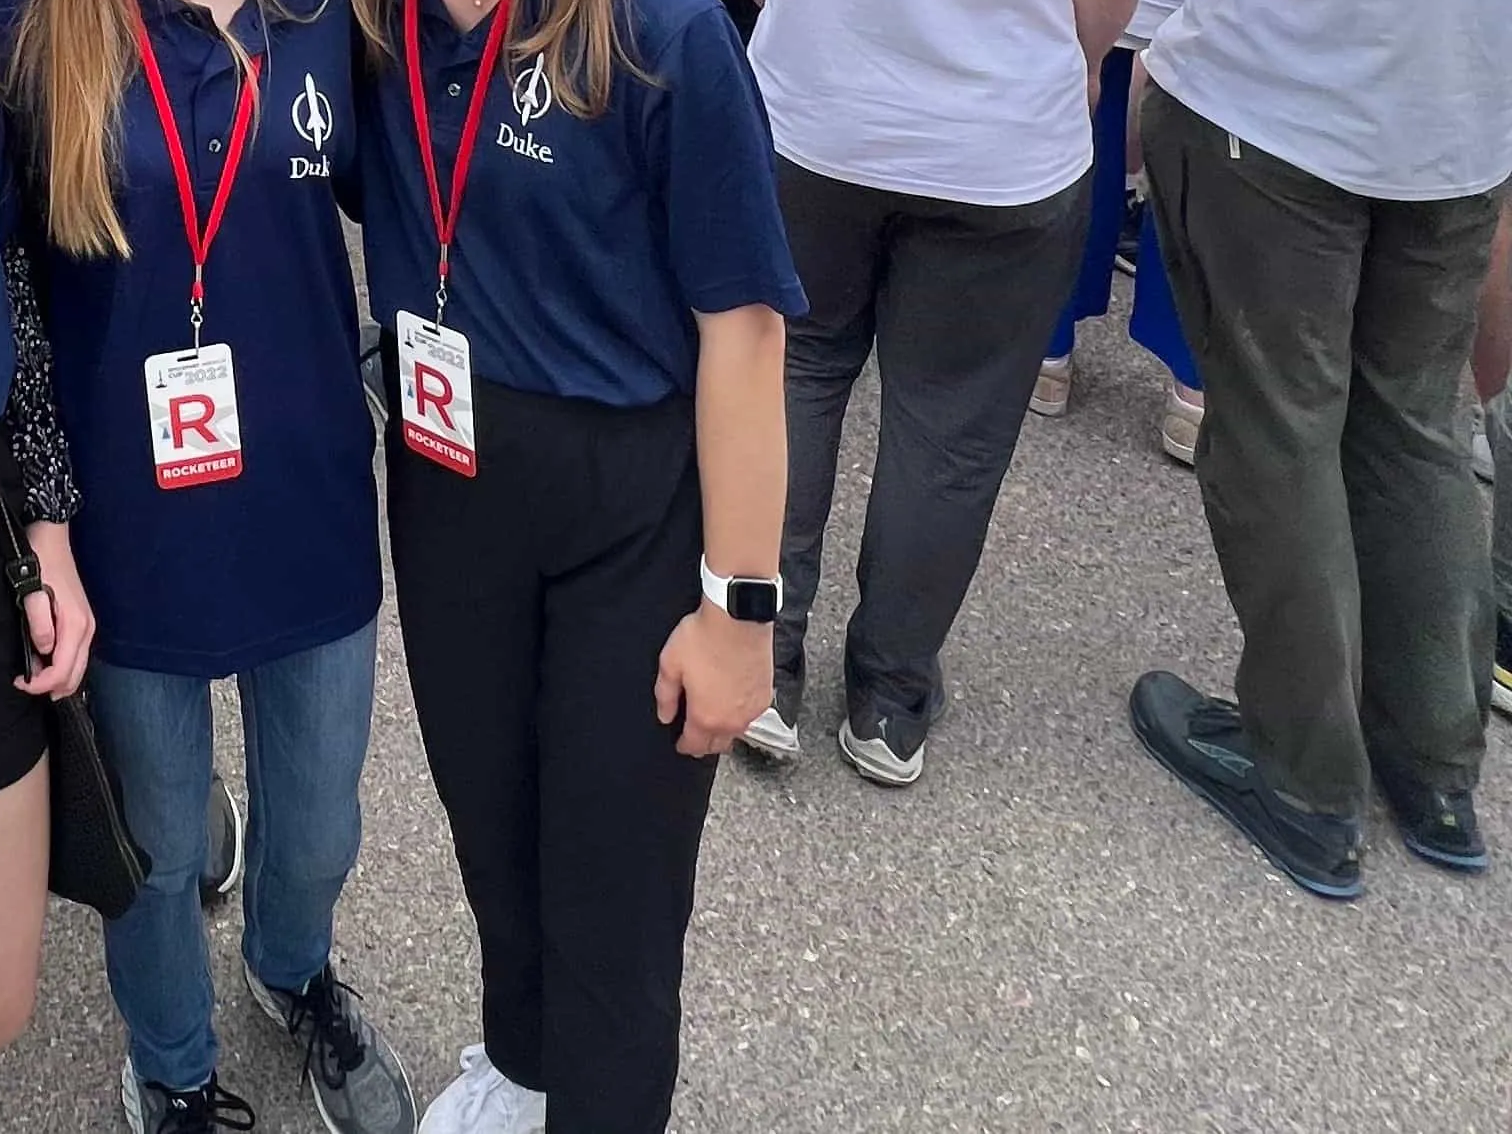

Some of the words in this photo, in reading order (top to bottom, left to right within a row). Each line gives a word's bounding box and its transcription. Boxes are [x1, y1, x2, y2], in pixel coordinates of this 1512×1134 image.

[496, 122, 554, 163] Duke
[414, 361, 456, 432] R
[169, 394, 220, 449] R
[407, 427, 470, 467] ROCKETEER
[163, 457, 236, 479] ROCKETEER
